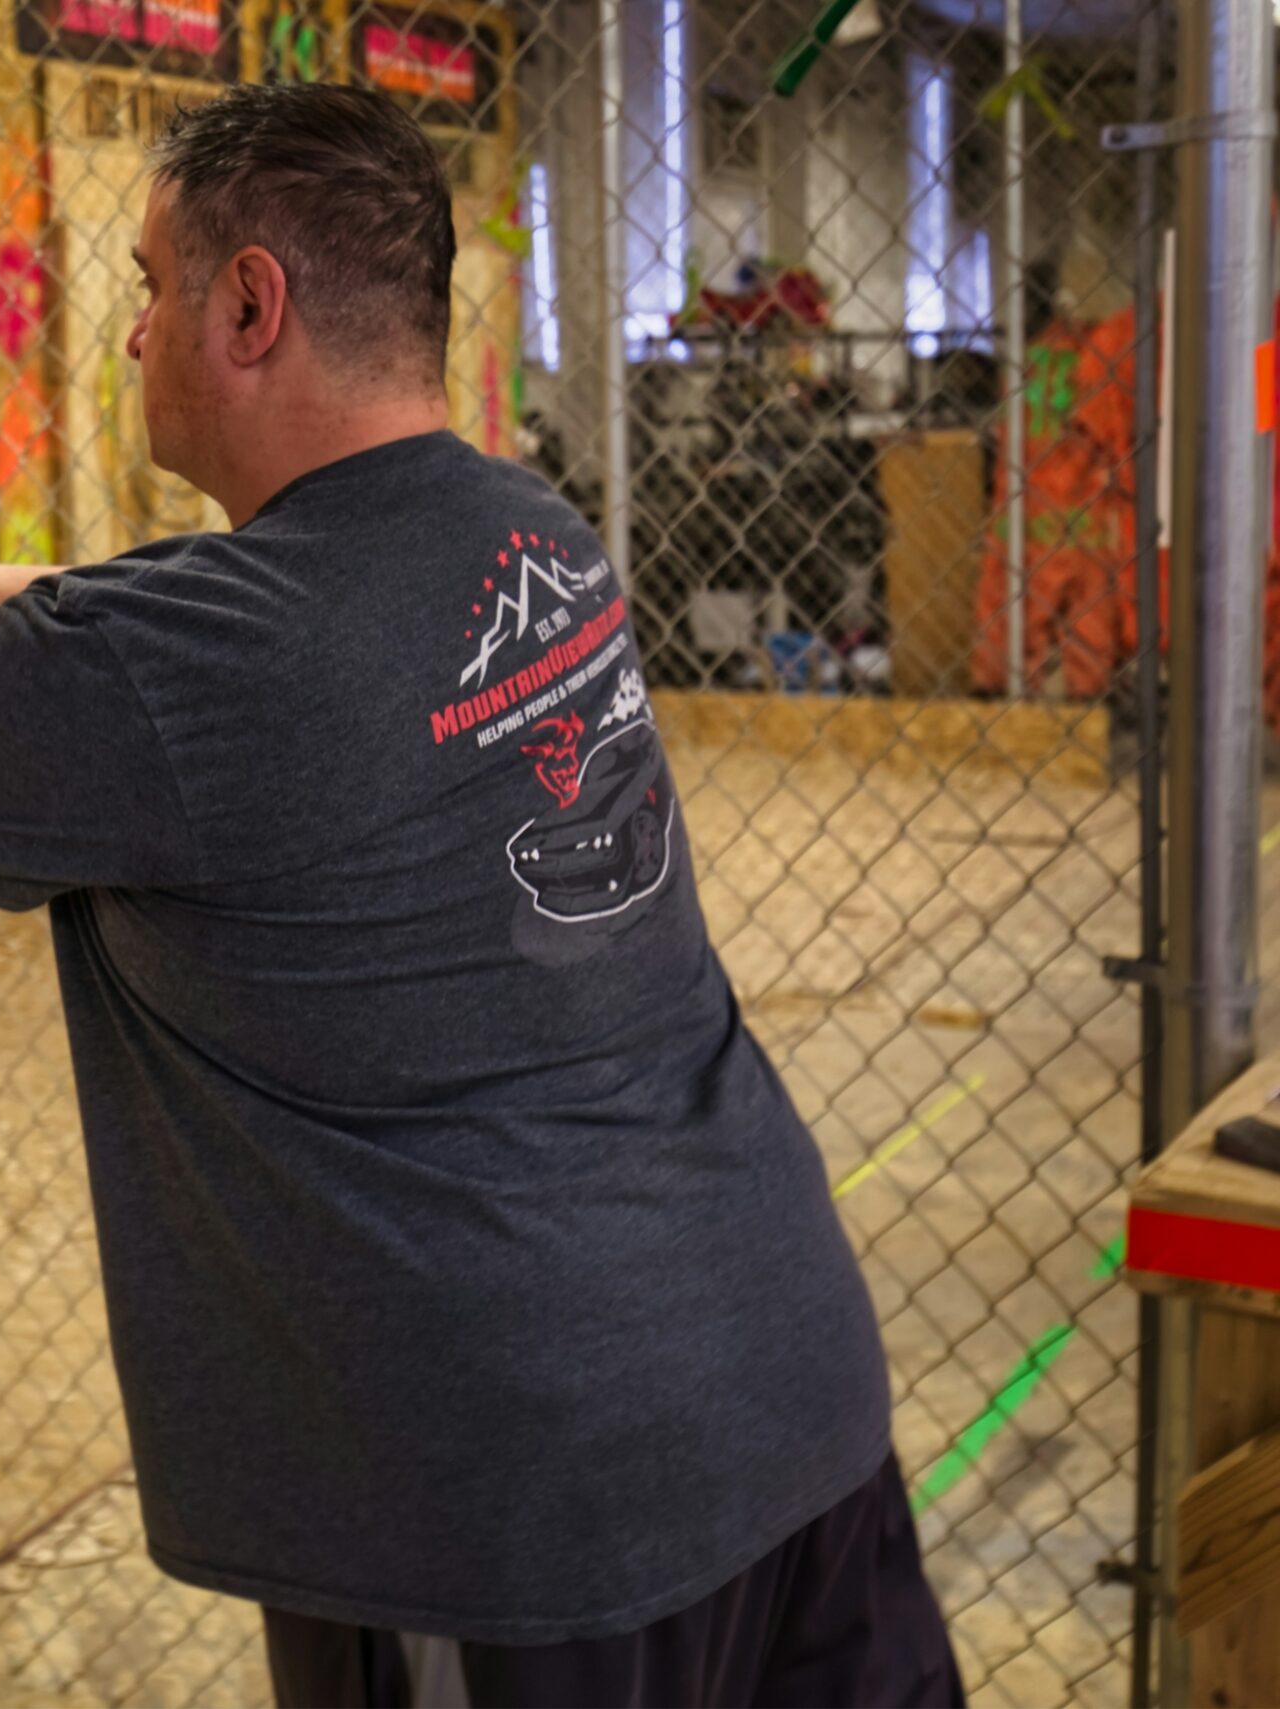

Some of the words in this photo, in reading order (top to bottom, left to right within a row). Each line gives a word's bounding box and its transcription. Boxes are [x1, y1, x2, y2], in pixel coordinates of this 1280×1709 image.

[476, 711, 524, 749] HELPING
[524, 690, 560, 722] PEOPLE
[558, 684, 567, 701] &
